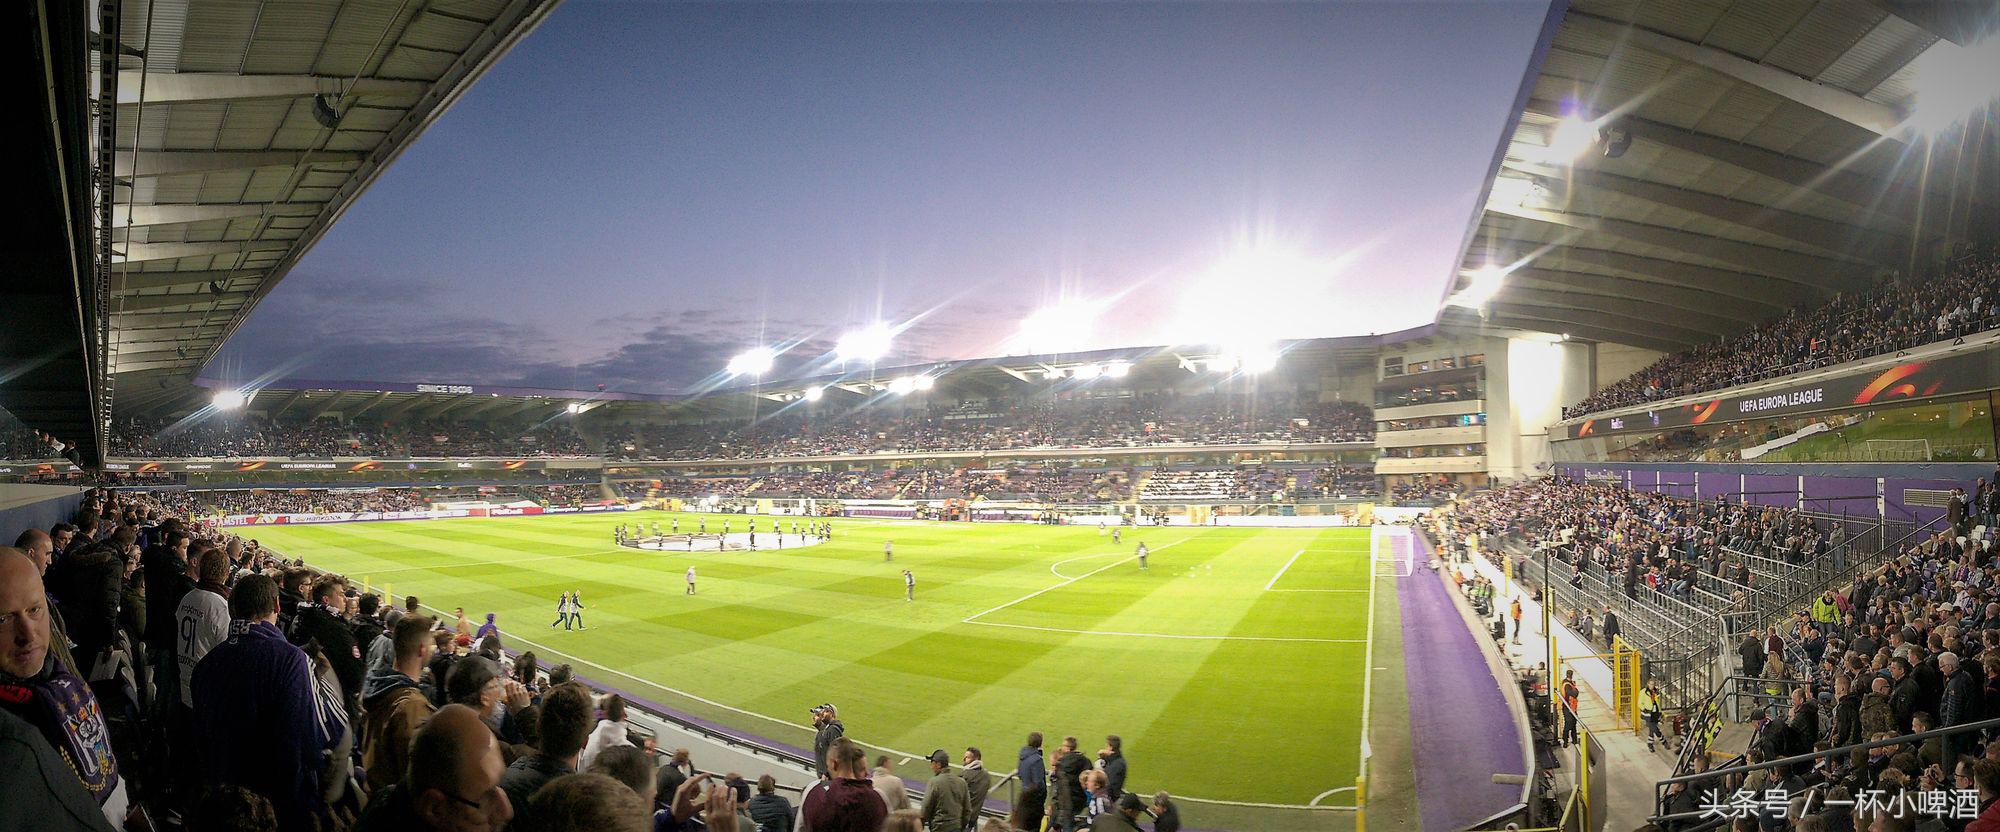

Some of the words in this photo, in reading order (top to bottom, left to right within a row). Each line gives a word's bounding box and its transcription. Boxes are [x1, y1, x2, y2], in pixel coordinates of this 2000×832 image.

[416, 384, 448, 393] SINCE
[448, 385, 473, 394] 1908
[1740, 399, 1758, 412] UEFA
[1758, 394, 1788, 410] EUROPA
[1788, 388, 1823, 406] LEAGUE
[181, 616, 197, 657] 91
